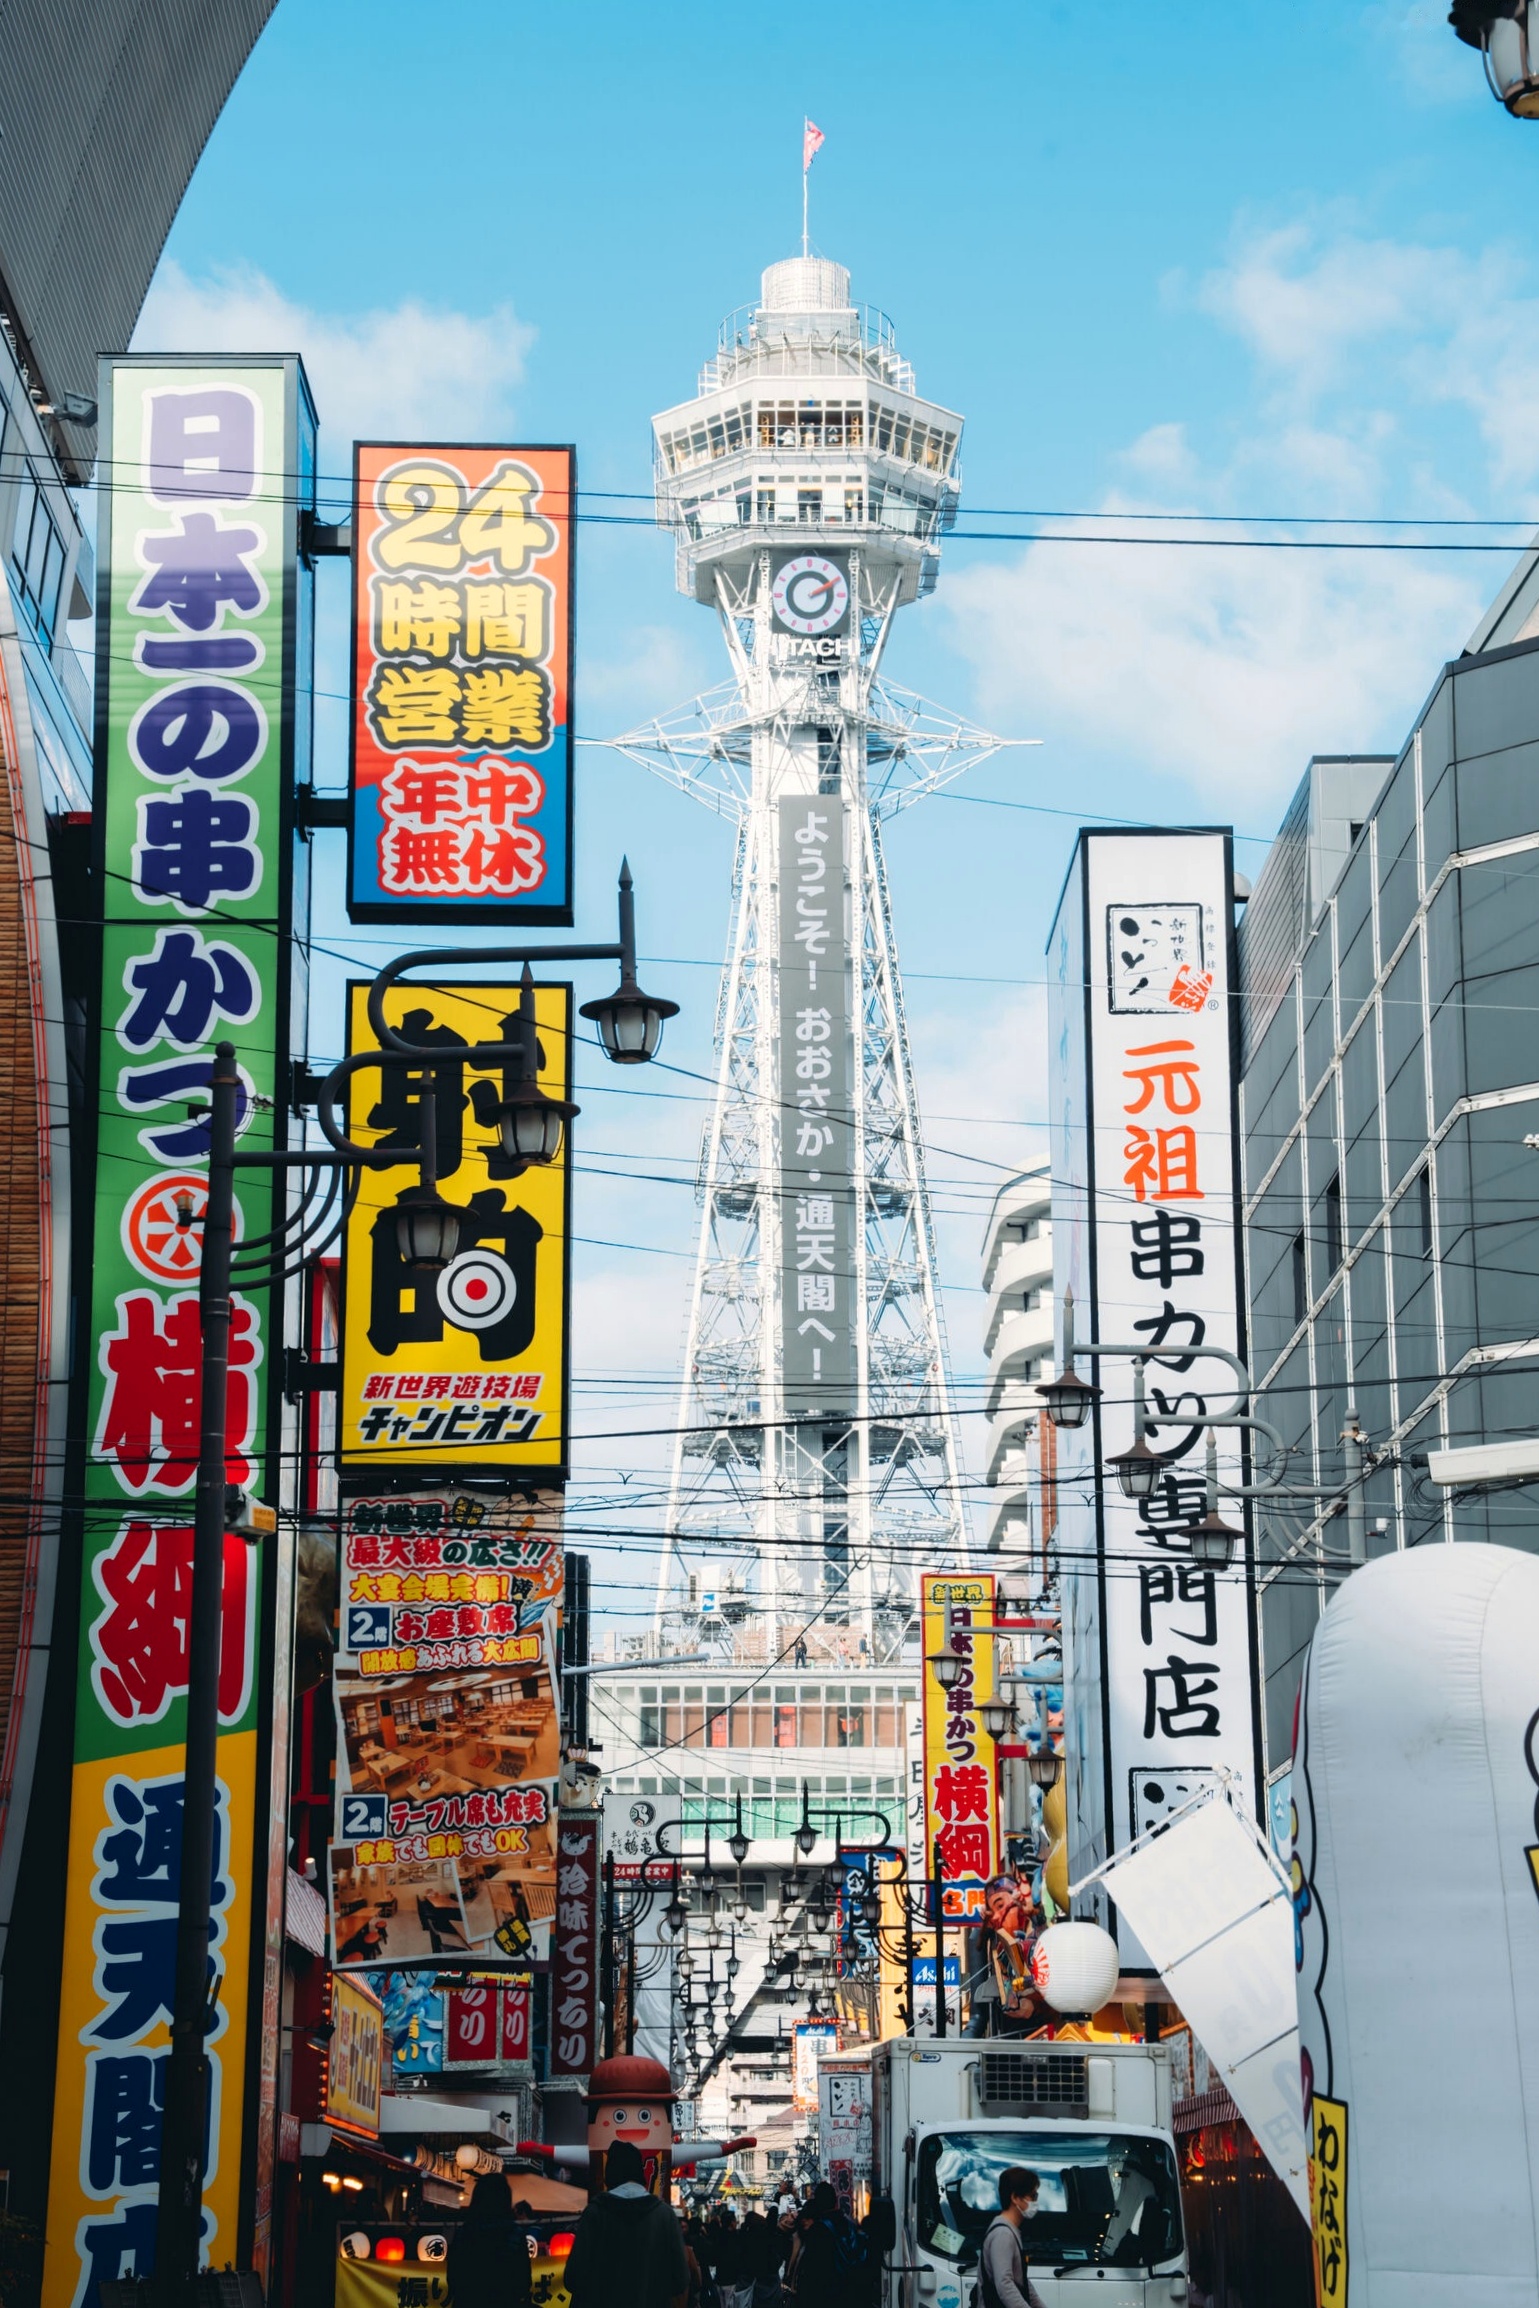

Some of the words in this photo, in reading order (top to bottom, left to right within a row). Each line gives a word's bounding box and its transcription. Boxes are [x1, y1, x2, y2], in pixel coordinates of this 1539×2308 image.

[376, 464, 554, 572] 24
[379, 580, 545, 660] 時間
[373, 667, 546, 748] 営業
[127, 388, 260, 1162] 日本一の串かつ
[389, 765, 534, 825] 年中
[390, 828, 534, 886] 無休
[365, 1374, 542, 1401] 新世界遊技場
[360, 1405, 544, 1443] チャンピオン
[350, 1611, 388, 1644] 2階
[395, 1604, 516, 1641] お座敷席
[360, 1637, 539, 1674] 開放感あふれる大広間
[346, 1801, 383, 1834] 2階
[390, 1790, 545, 1833] テーブル席も充実
[934, 1764, 990, 1882] 横綱
[356, 1828, 526, 1865] 家族でも団体でもOK
[557, 1864, 590, 2067] 珍味てっちり
[1318, 2111, 1342, 2297] わなげ
